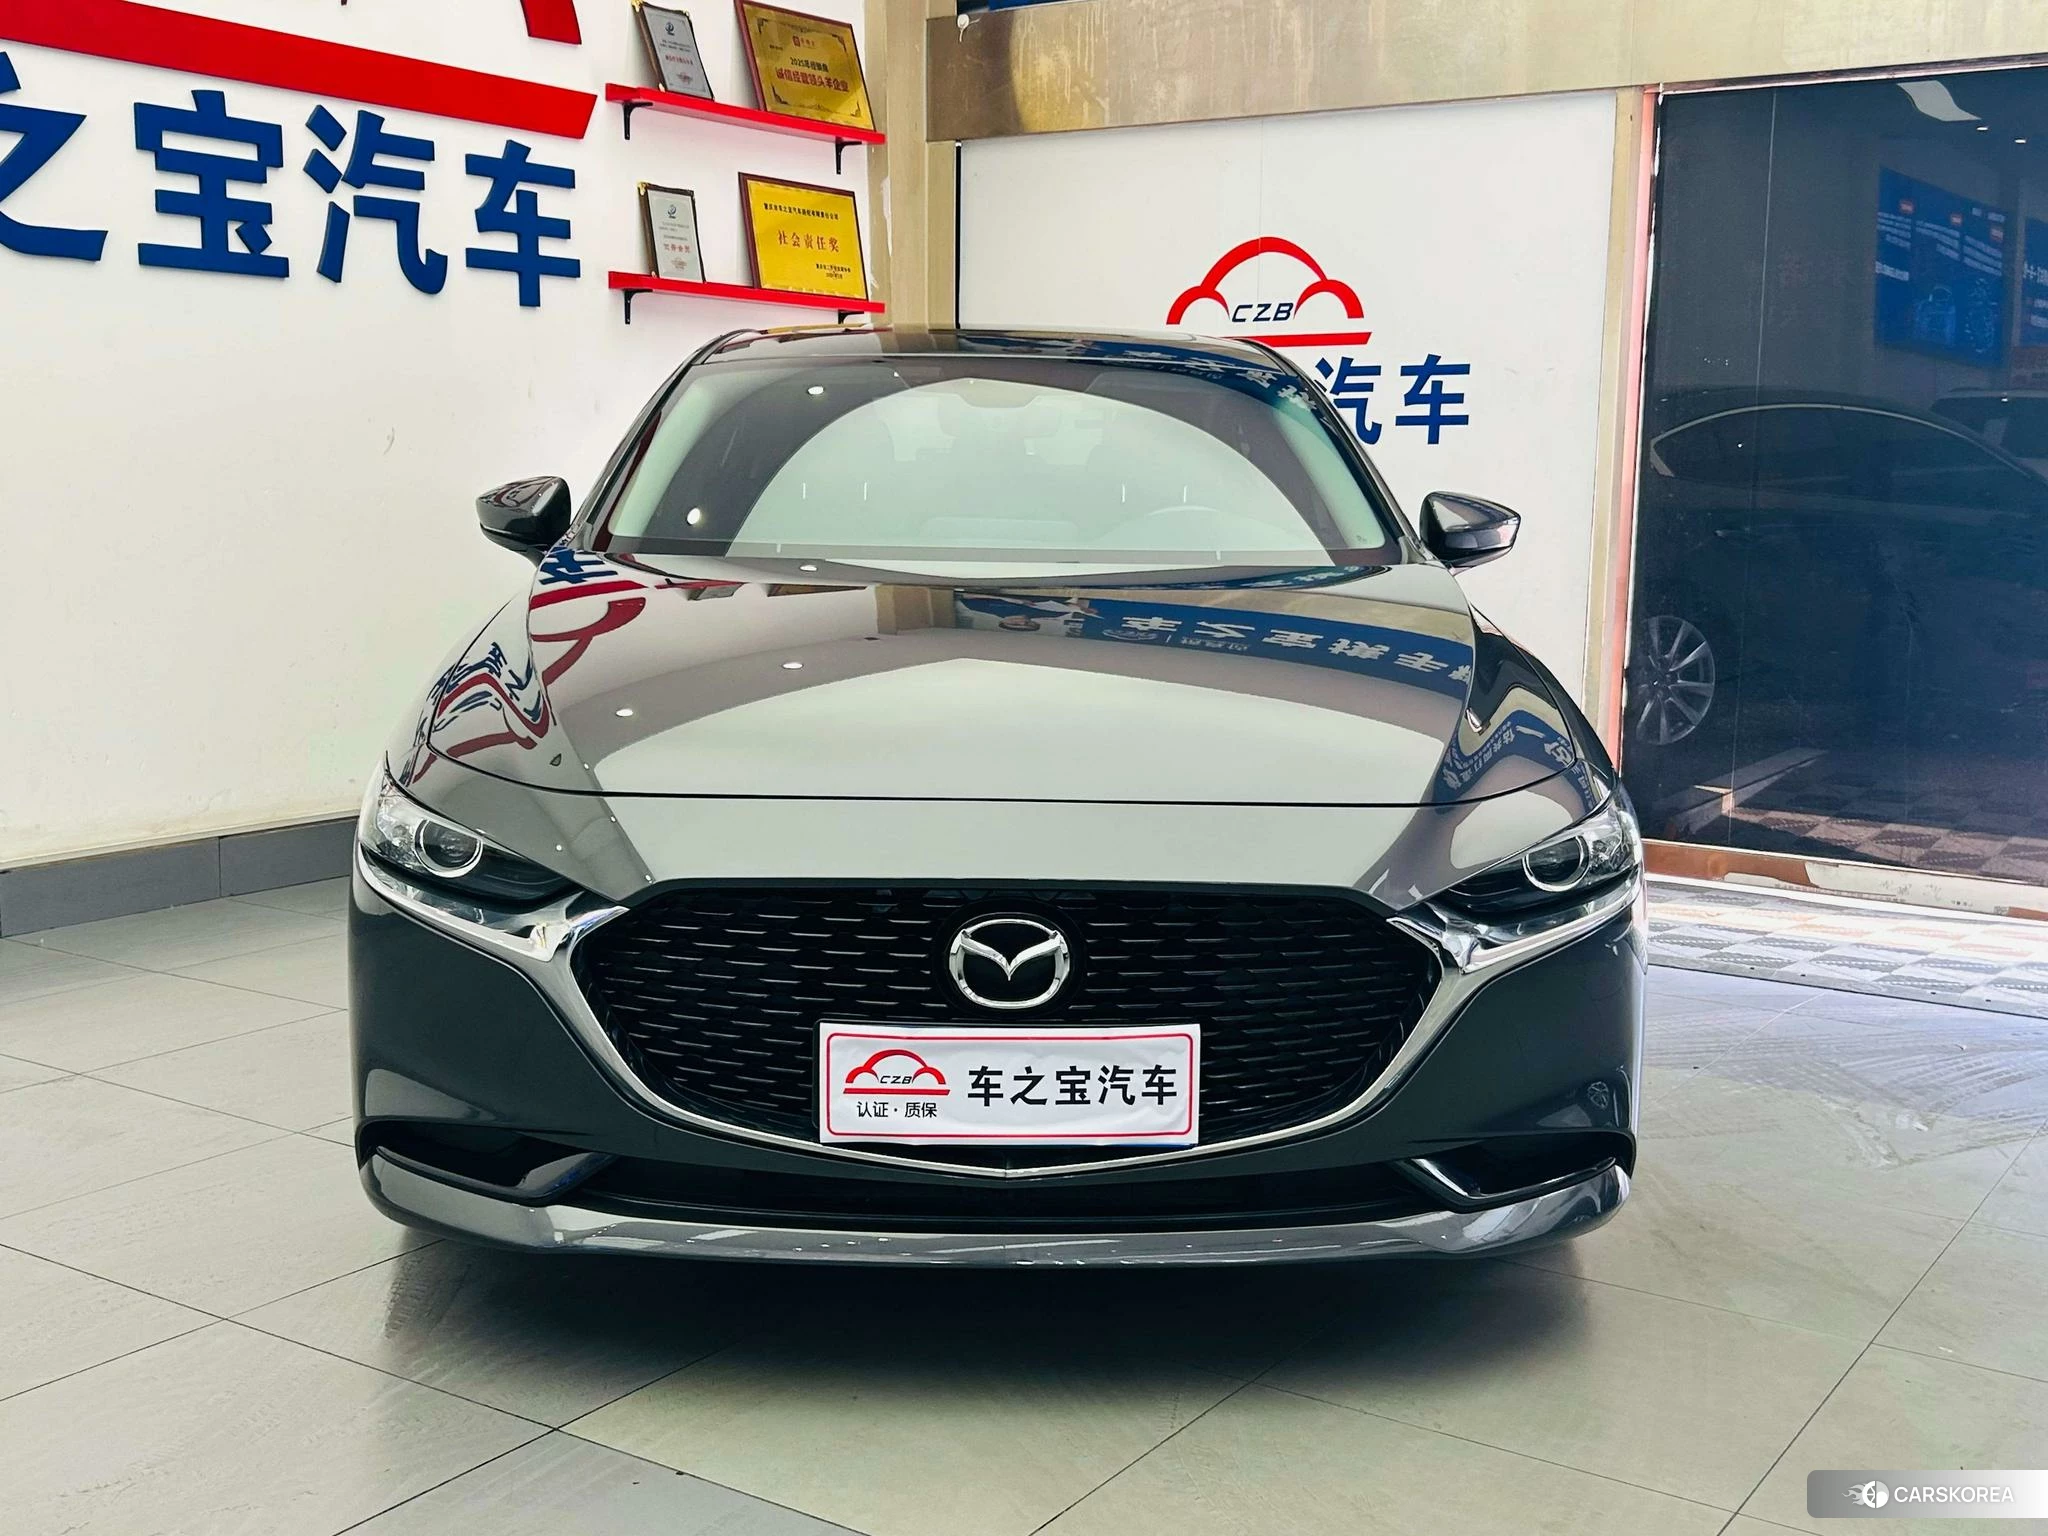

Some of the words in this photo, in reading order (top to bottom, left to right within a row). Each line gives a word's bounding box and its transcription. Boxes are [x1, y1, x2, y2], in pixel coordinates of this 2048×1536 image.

[778, 229, 839, 253] 社会责任奖
[1231, 302, 1294, 323] CZB
[1313, 353, 1471, 445] 汽车
[879, 1074, 912, 1085] CZB
[967, 1064, 1177, 1107] 车之宝汽车
